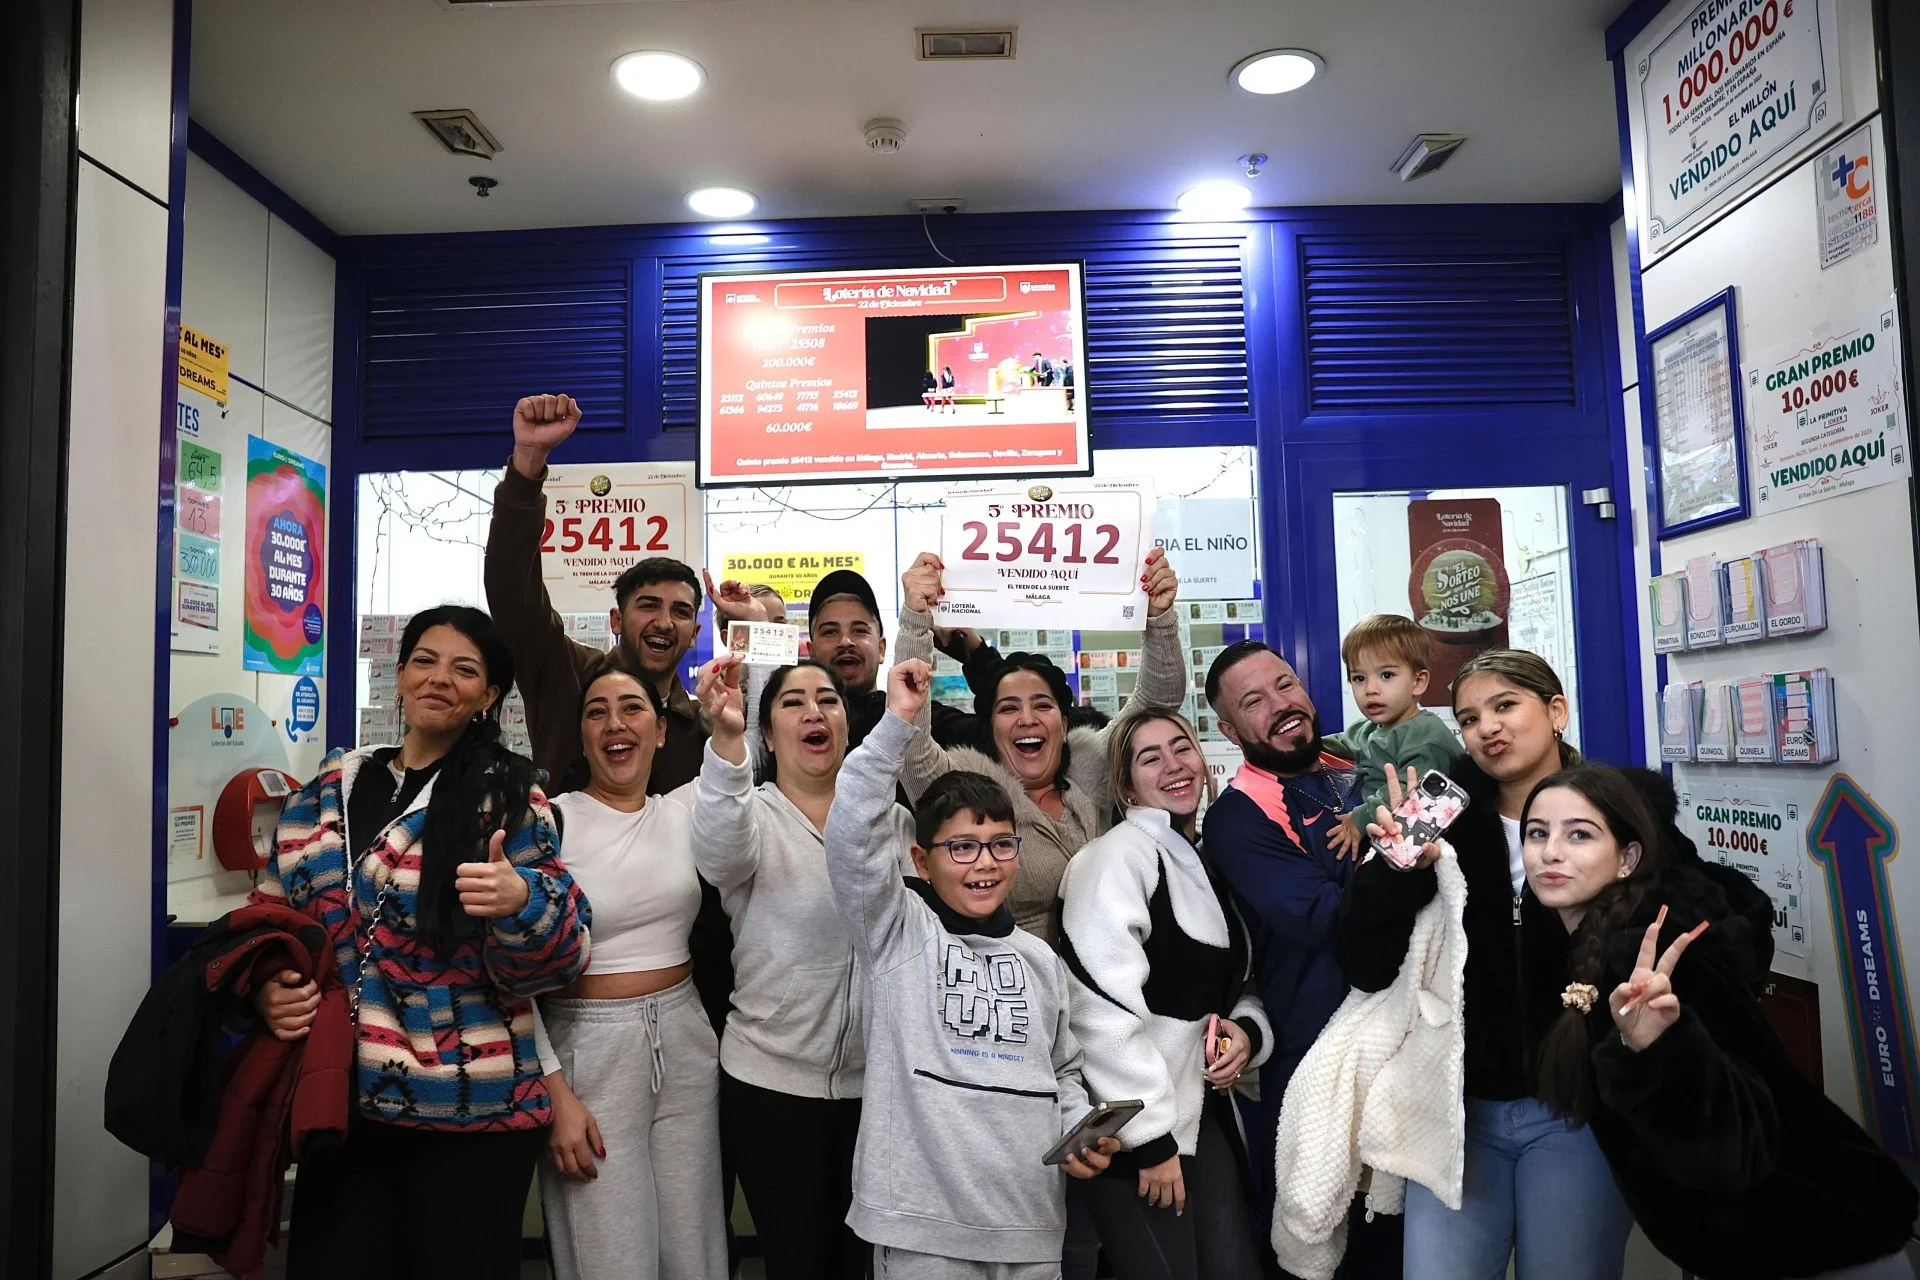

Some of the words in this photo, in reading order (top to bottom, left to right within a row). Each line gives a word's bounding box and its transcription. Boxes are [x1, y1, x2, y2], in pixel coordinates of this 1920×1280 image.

[1691, 0, 1735, 38] PREM
[1765, 31, 1786, 52] ESPAÑA
[1729, 112, 1740, 128] EL
[1741, 80, 1777, 118] MILLÓN
[1669, 133, 1742, 200] VENDIDO
[1749, 80, 1796, 145] AQUÍ
[876, 285, 894, 297] de
[896, 280, 957, 297] Navidad
[184, 330, 198, 348] AL
[762, 356, 816, 369] 200.000€
[1765, 360, 1810, 392] GRAN
[1812, 333, 1875, 374] PREMIO
[180, 365, 216, 390] DREAMS
[788, 377, 832, 389] Premios
[1810, 416, 1817, 425] LA
[1818, 406, 1848, 421] PRIMITIVA
[1870, 403, 1889, 416] JOKER
[766, 422, 813, 433] 60.000€
[1770, 453, 1837, 488] VENDIDO
[1840, 431, 1885, 468] AQUÍ
[575, 497, 646, 514] PREMIO
[1011, 503, 1095, 520] PREMIO
[273, 517, 304, 536] AHORA
[540, 515, 669, 553] 25412
[962, 521, 1120, 565] 25412
[1185, 538, 1203, 550] EL
[1207, 534, 1248, 550] NIÑO
[273, 549, 285, 565] AL
[286, 552, 302, 569] MES
[563, 557, 607, 567] VENDIDO
[609, 556, 635, 567] AQUÍ
[728, 557, 783, 570] 30.000
[800, 557, 819, 568] AL
[1453, 561, 1466, 573] EL
[269, 565, 307, 587] DURANTE
[997, 568, 1048, 579] VENDIDO
[1051, 567, 1079, 580] AQUÍ
[1437, 564, 1480, 592] SORTEO
[270, 583, 282, 598] 30
[282, 584, 304, 603] AÑOS
[794, 589, 812, 598] DR
[1441, 594, 1459, 610] NOS
[1460, 585, 1481, 603] UNE
[1725, 622, 1759, 634] EUROMILLON
[1771, 619, 1778, 627] EL
[1779, 616, 1801, 627] GORDO
[753, 628, 784, 636] 25412
[1690, 629, 1717, 640] BONOLOTO
[1657, 637, 1679, 647] PRIMITIVA
[1787, 736, 1803, 745] EURO
[1663, 747, 1686, 755] REDUCIDA
[1700, 747, 1724, 756] QUINIGOL
[1739, 747, 1765, 755] QUINIELA
[1783, 748, 1808, 757] DREAMS
[1696, 805, 1730, 825] GRAN
[1732, 810, 1782, 831] PREMIO
[1777, 881, 1792, 890] JOKER
[1857, 909, 1880, 1000] DREAMS
[997, 1054, 1024, 1062] MINDSET
[1876, 1025, 1895, 1087] EURO
